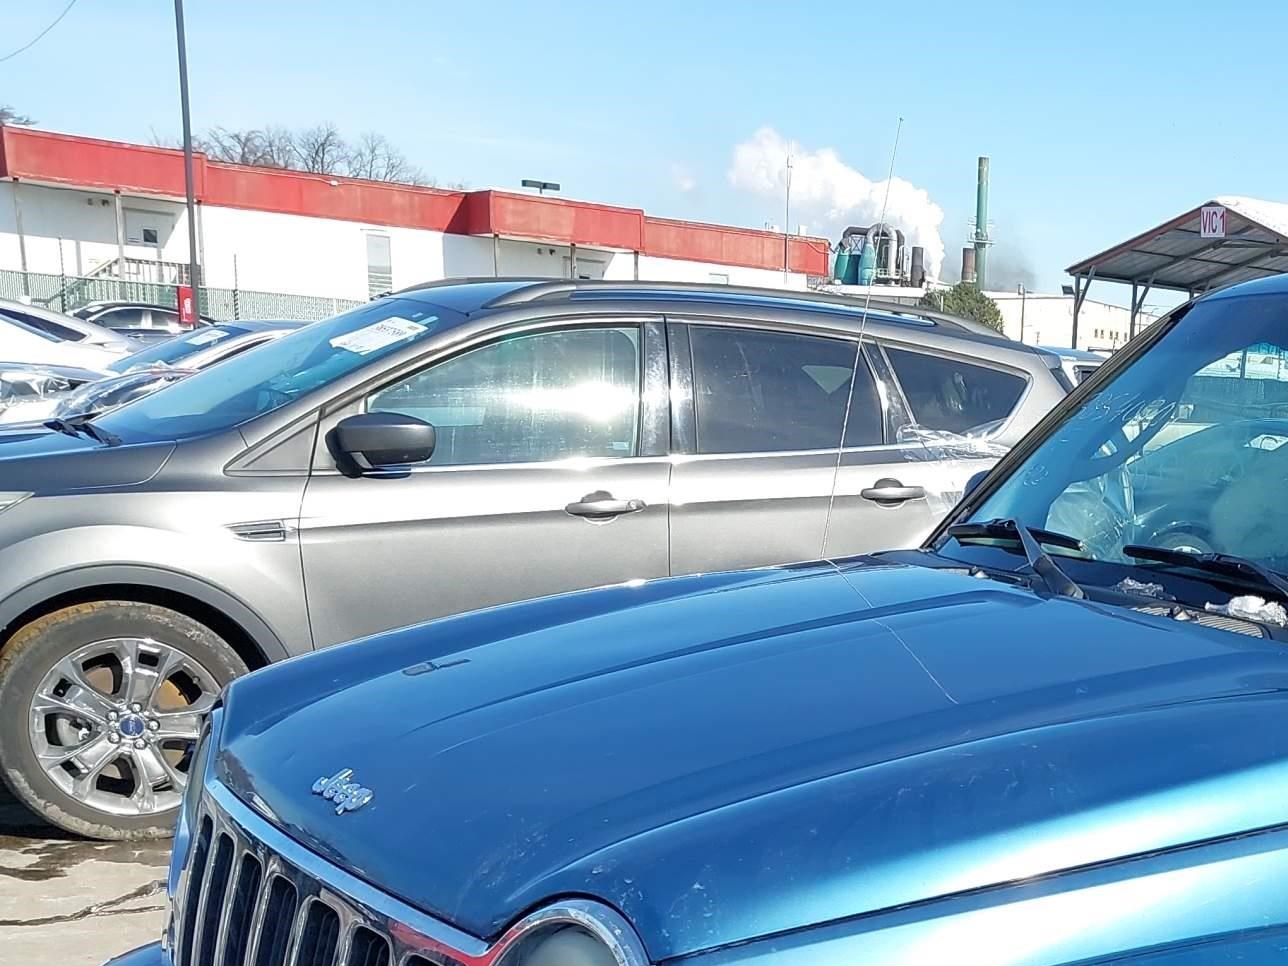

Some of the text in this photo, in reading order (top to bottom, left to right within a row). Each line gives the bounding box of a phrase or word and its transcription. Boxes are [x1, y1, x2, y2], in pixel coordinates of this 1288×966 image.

[1202, 210, 1225, 233] VIC 1
[312, 768, 373, 815] Jeep
